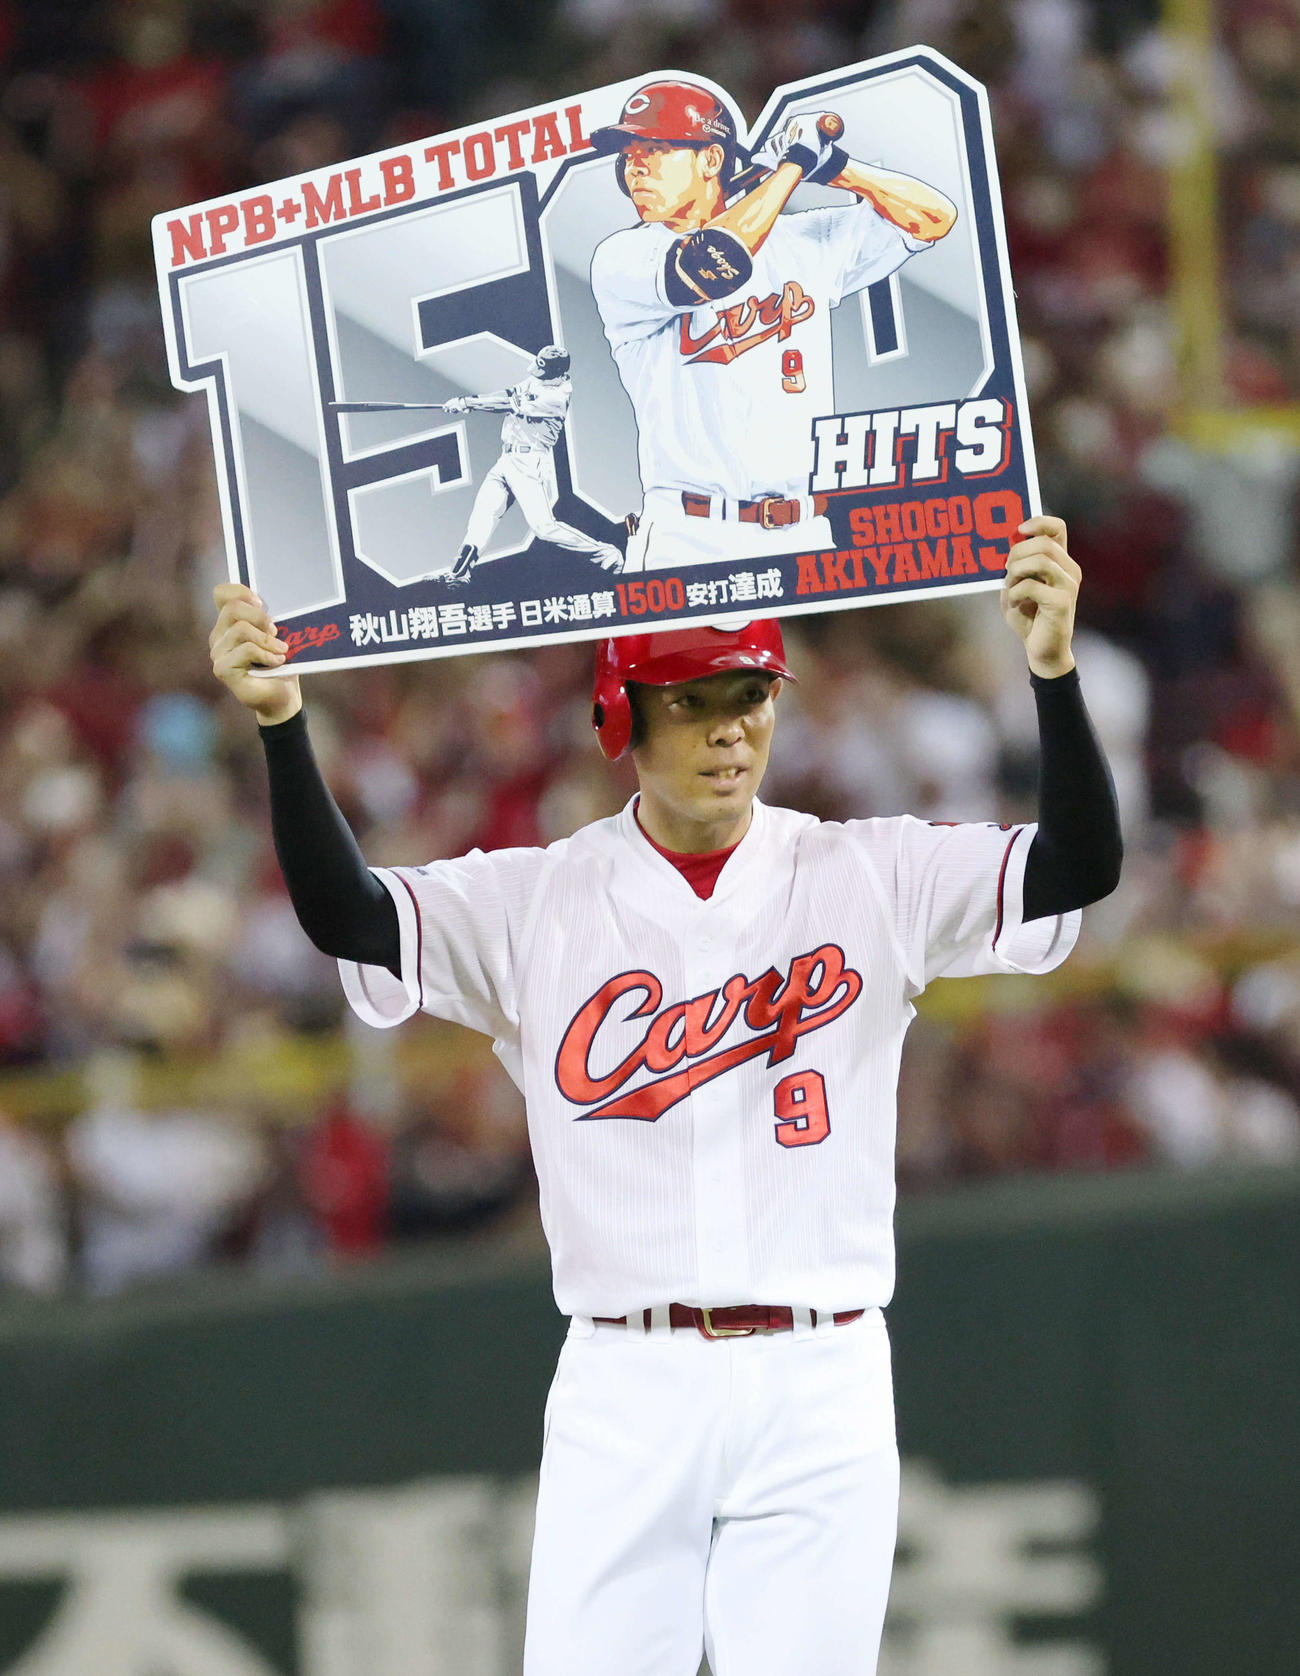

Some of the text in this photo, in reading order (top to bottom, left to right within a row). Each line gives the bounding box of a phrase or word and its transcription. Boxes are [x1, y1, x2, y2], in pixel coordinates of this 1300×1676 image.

[166, 104, 596, 267] NPB+MLB TOTAL
[781, 349, 807, 394] 9
[811, 397, 1008, 493] HITS
[849, 494, 974, 548] SHOGO
[972, 489, 1026, 572] 9
[795, 535, 979, 596] AKIYAMA
[554, 943, 863, 1123] Carp
[774, 1069, 831, 1148] 9
